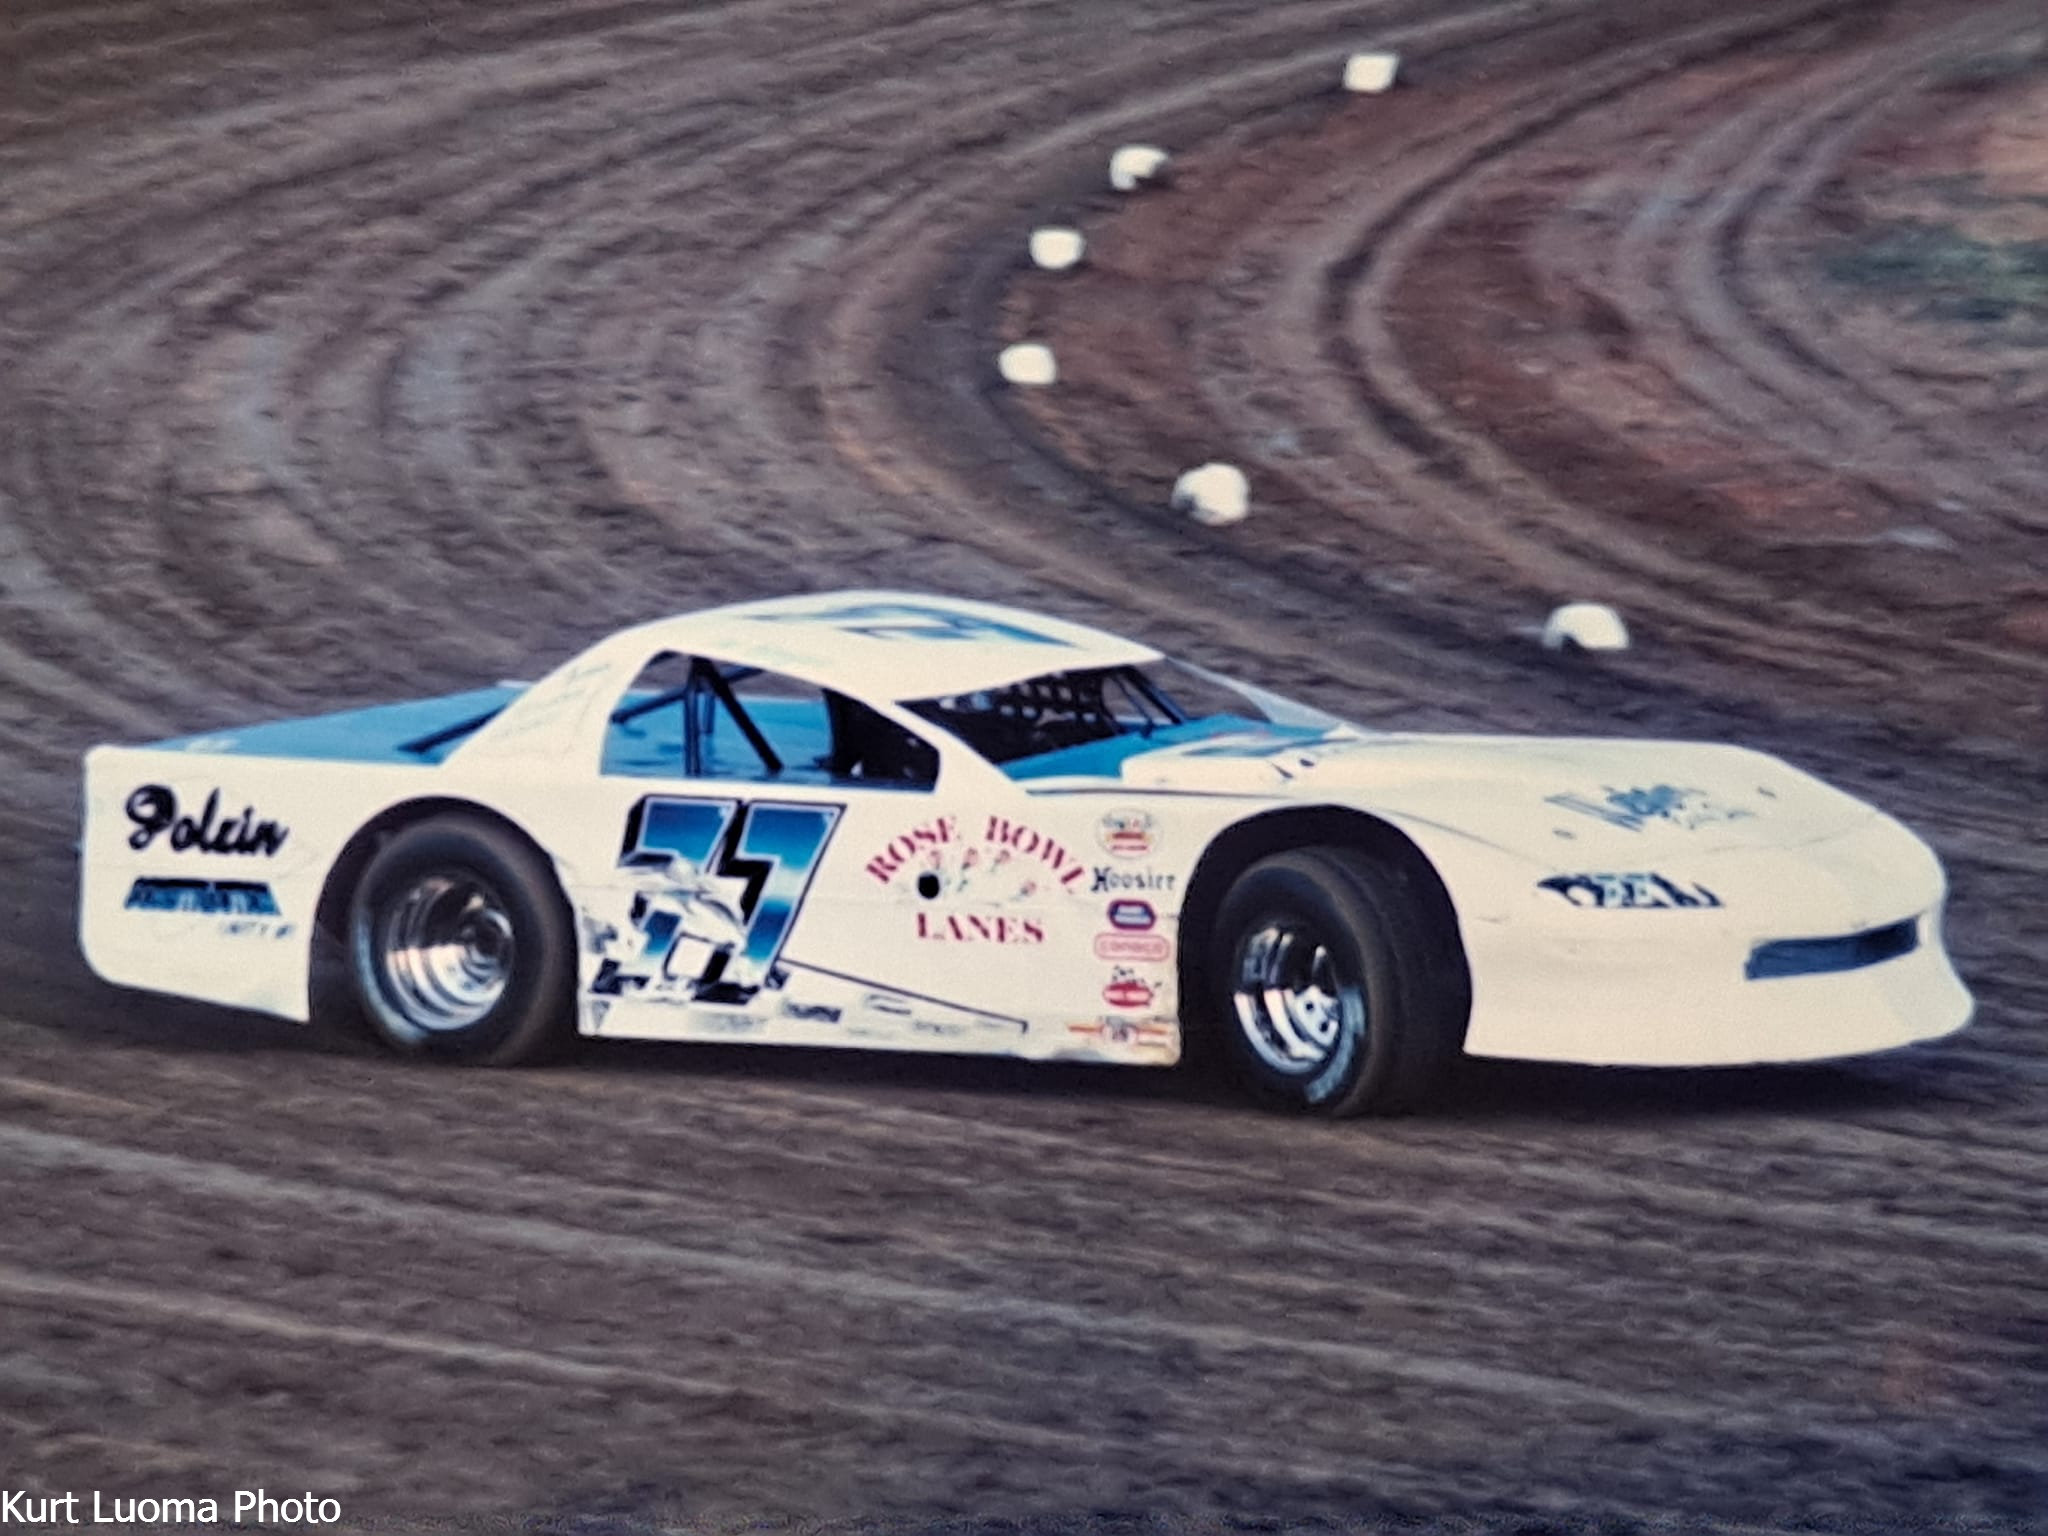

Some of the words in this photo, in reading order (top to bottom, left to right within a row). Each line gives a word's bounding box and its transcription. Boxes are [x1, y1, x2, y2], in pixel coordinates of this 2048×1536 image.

[865, 814, 959, 885] ROSE
[984, 814, 1085, 895] BOWL
[1090, 865, 1176, 893] Hoosier
[616, 792, 848, 1006] 77
[916, 911, 1045, 943] LANES
